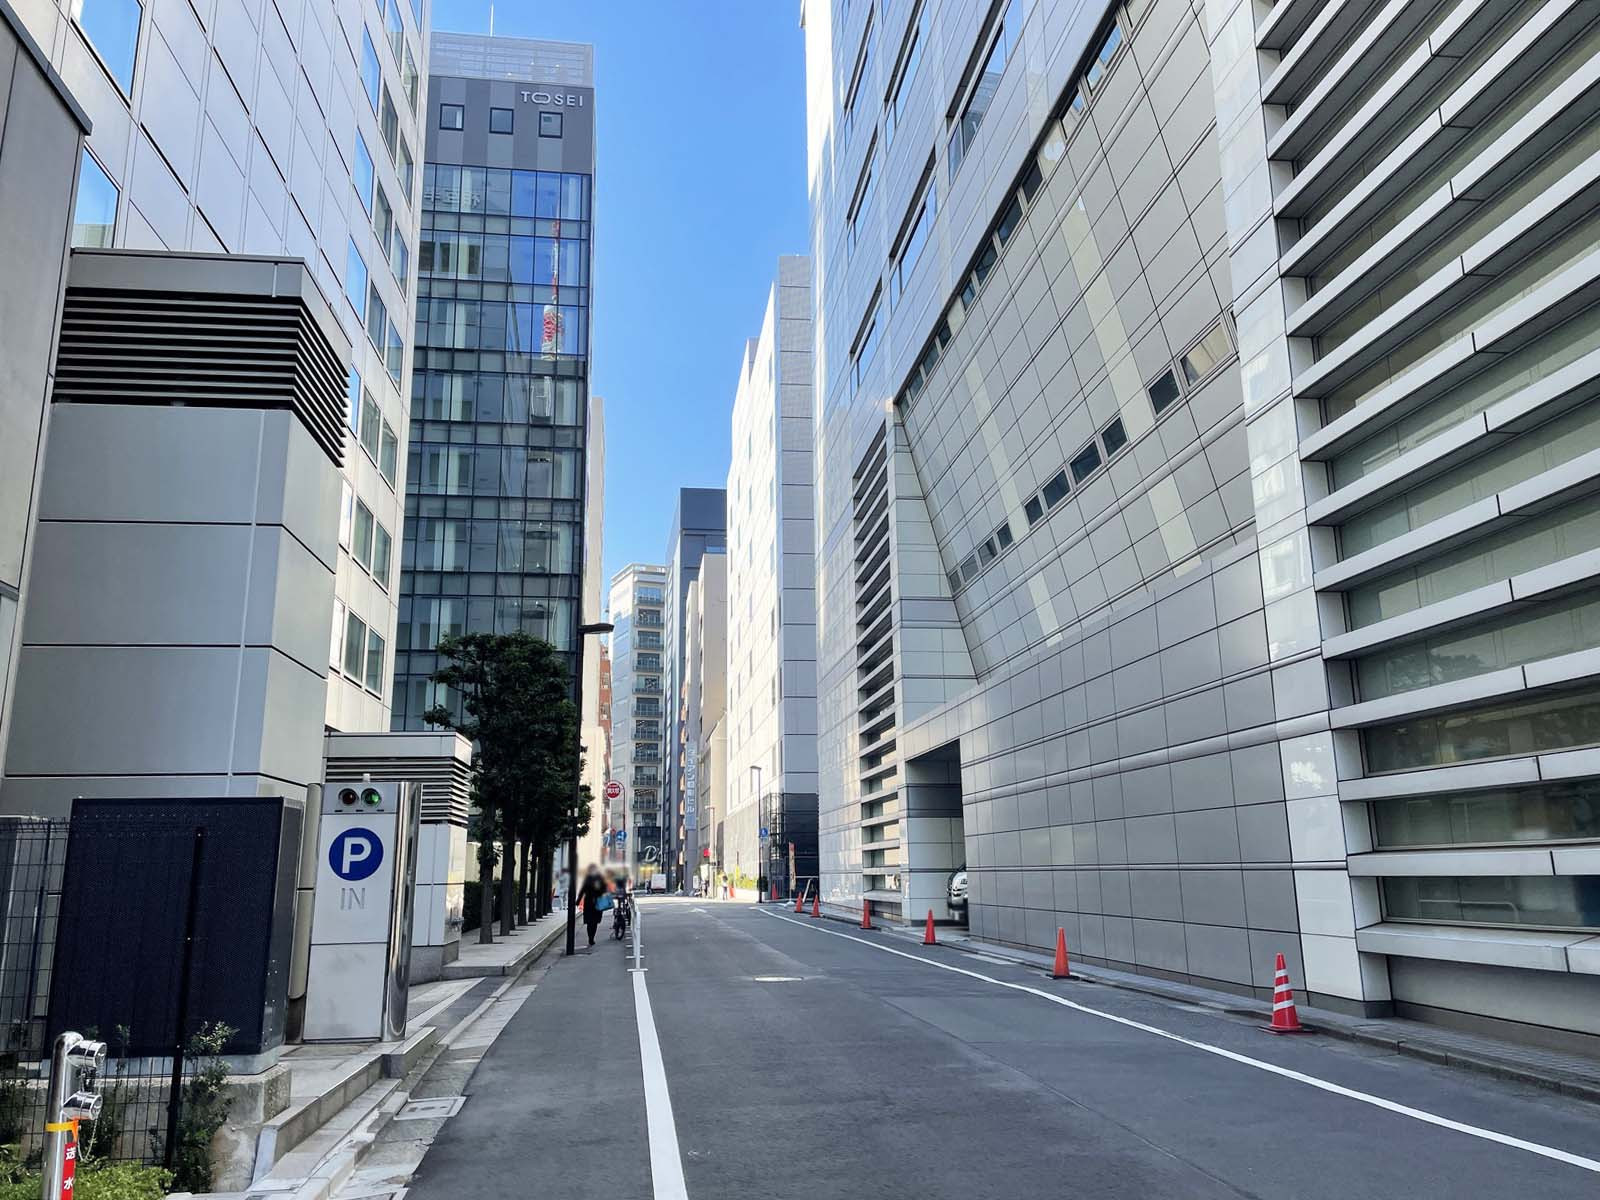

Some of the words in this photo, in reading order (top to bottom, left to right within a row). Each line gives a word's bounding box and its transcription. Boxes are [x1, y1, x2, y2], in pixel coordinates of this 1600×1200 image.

[521, 91, 583, 107] TOSEI
[341, 836, 372, 874] P
[340, 887, 366, 910] IN
